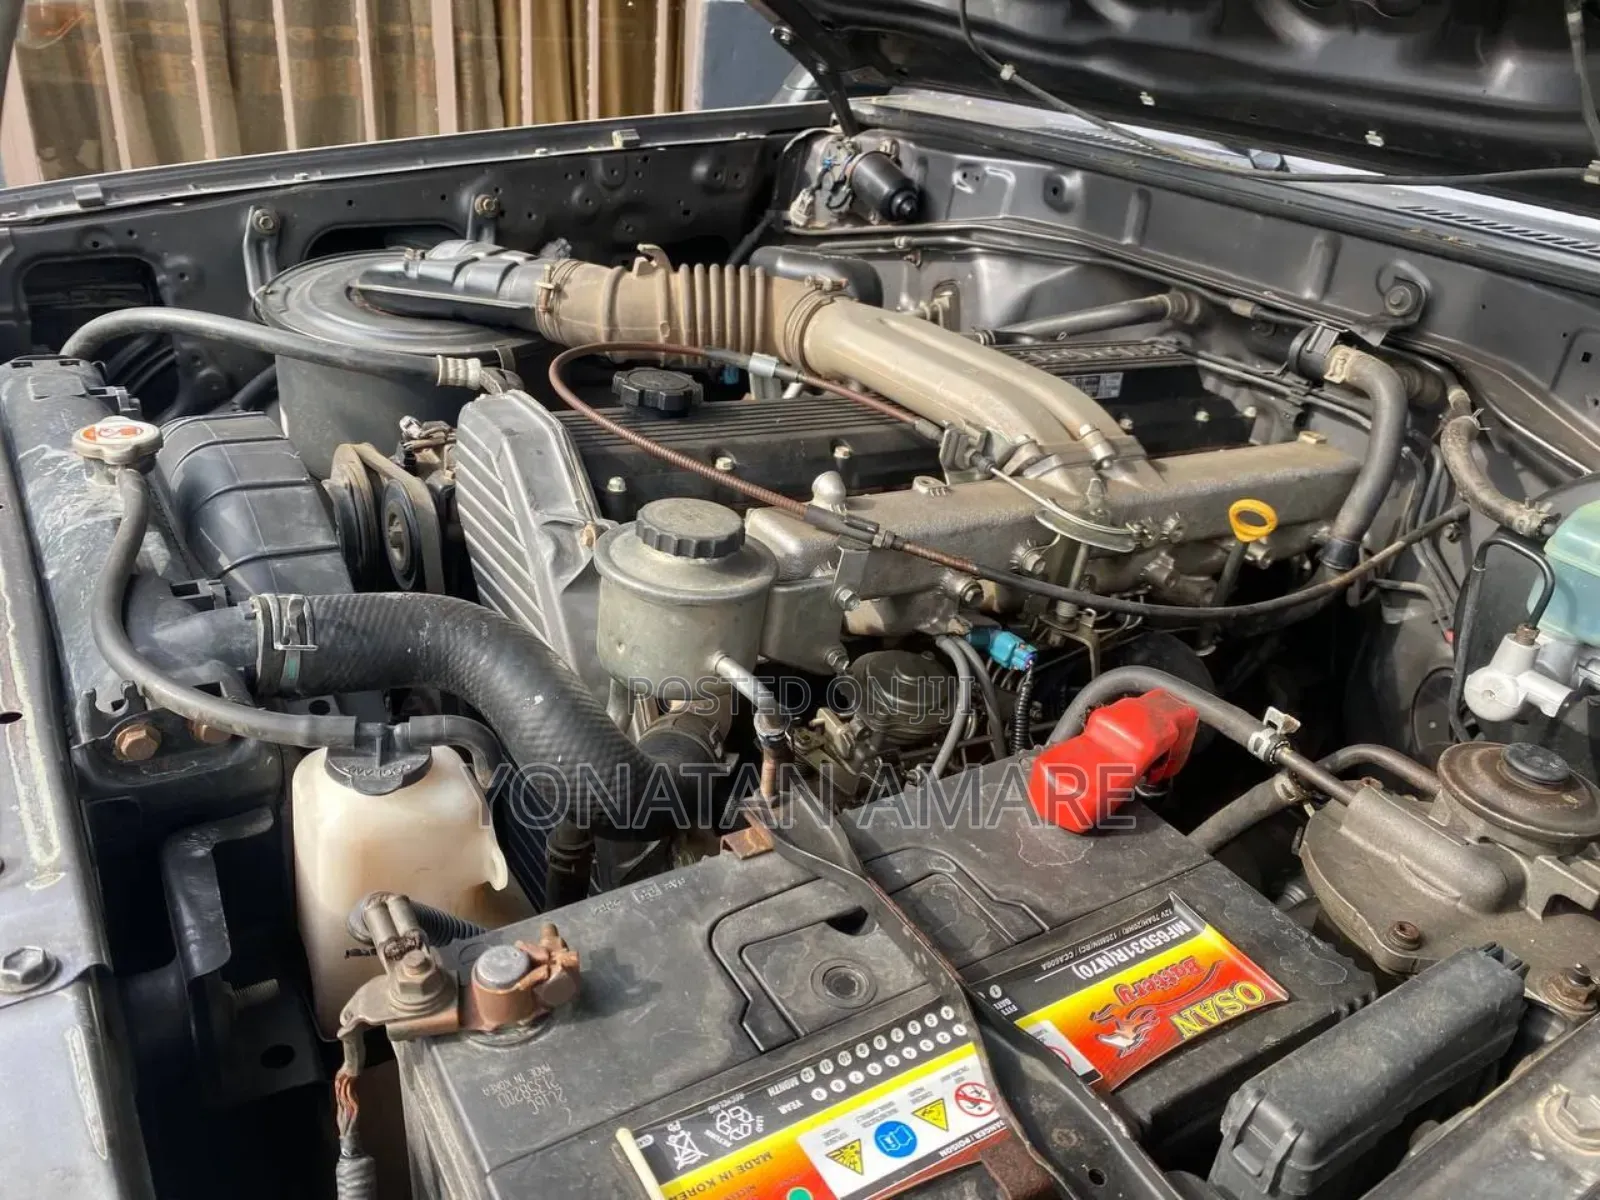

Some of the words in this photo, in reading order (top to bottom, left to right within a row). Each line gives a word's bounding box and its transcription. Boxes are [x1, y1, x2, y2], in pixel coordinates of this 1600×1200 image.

[1071, 919, 1192, 981] MF65D31R(N70)
[1114, 956, 1201, 1006] Battery
[1170, 981, 1266, 1041] OSAN
[767, 1077, 799, 1097] MONTH
[778, 1099, 804, 1114] YEAR
[938, 1139, 971, 1158] POISON
[738, 1152, 773, 1173] MADE
[719, 1170, 736, 1182] IN
